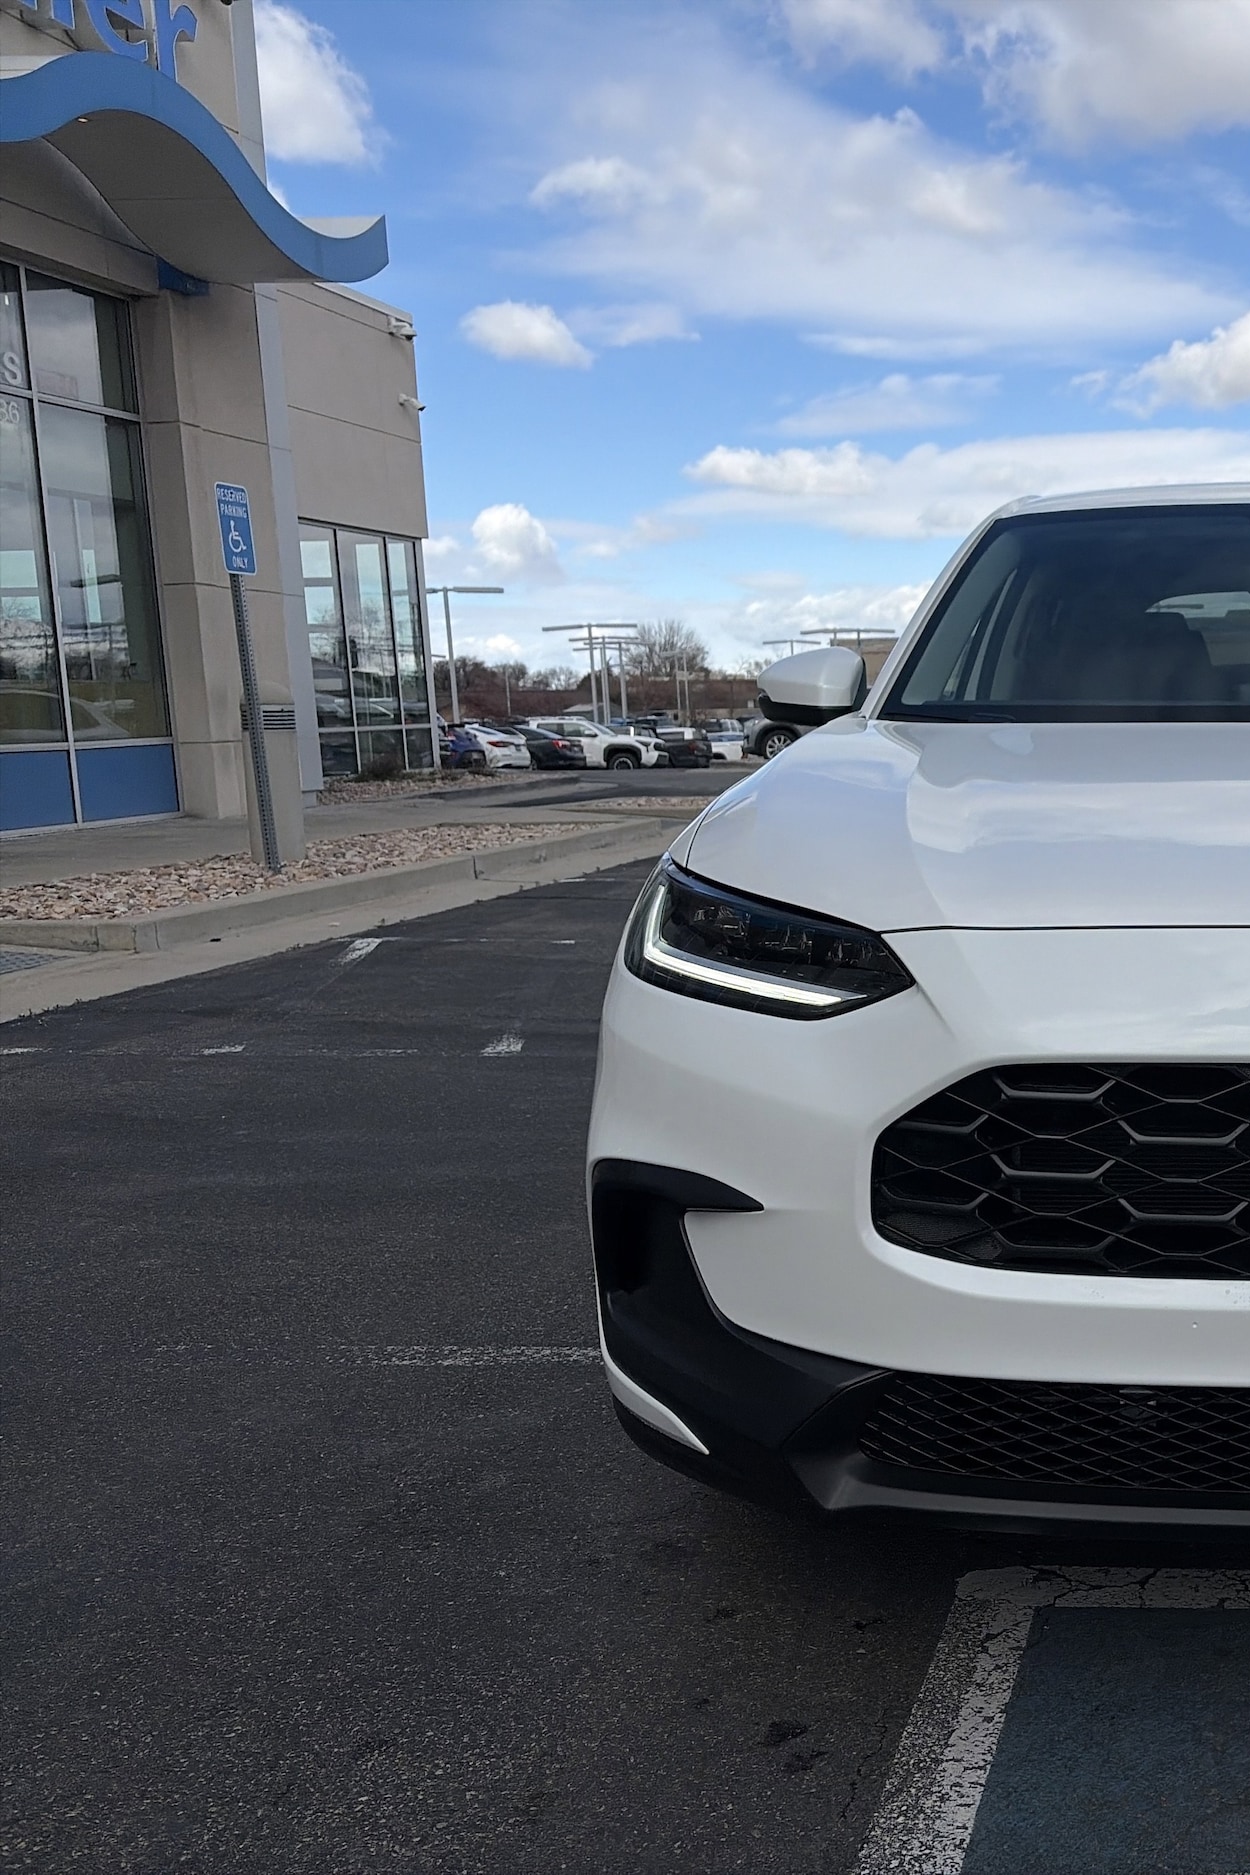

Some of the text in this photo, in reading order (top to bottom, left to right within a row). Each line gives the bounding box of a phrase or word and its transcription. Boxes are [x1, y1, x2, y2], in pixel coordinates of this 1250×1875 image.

[216, 487, 247, 504] RESERVED
[220, 503, 248, 519] PARKING
[232, 555, 248, 569] ONLY
